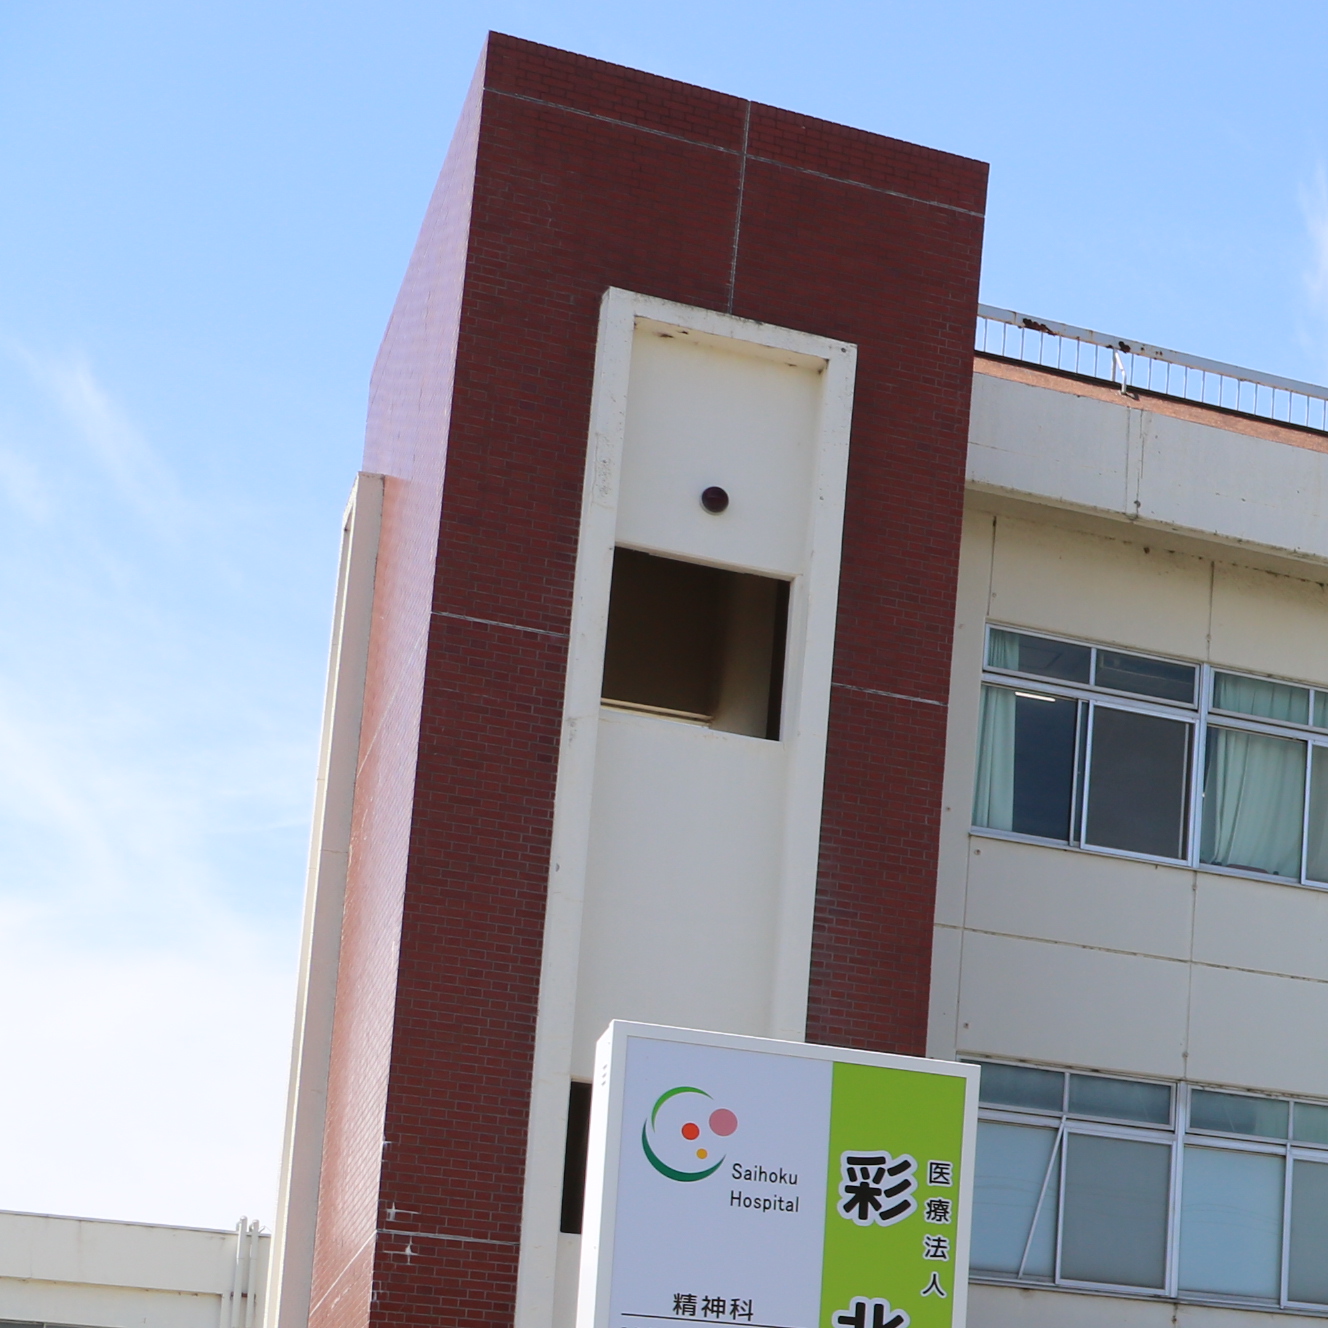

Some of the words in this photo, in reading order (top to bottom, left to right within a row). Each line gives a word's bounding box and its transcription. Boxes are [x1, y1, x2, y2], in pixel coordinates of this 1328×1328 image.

[731, 1162, 798, 1185] Saihoku
[730, 1190, 799, 1213] Hospital
[921, 1162, 952, 1297] 医療法人
[672, 1292, 754, 1321] 精神科
